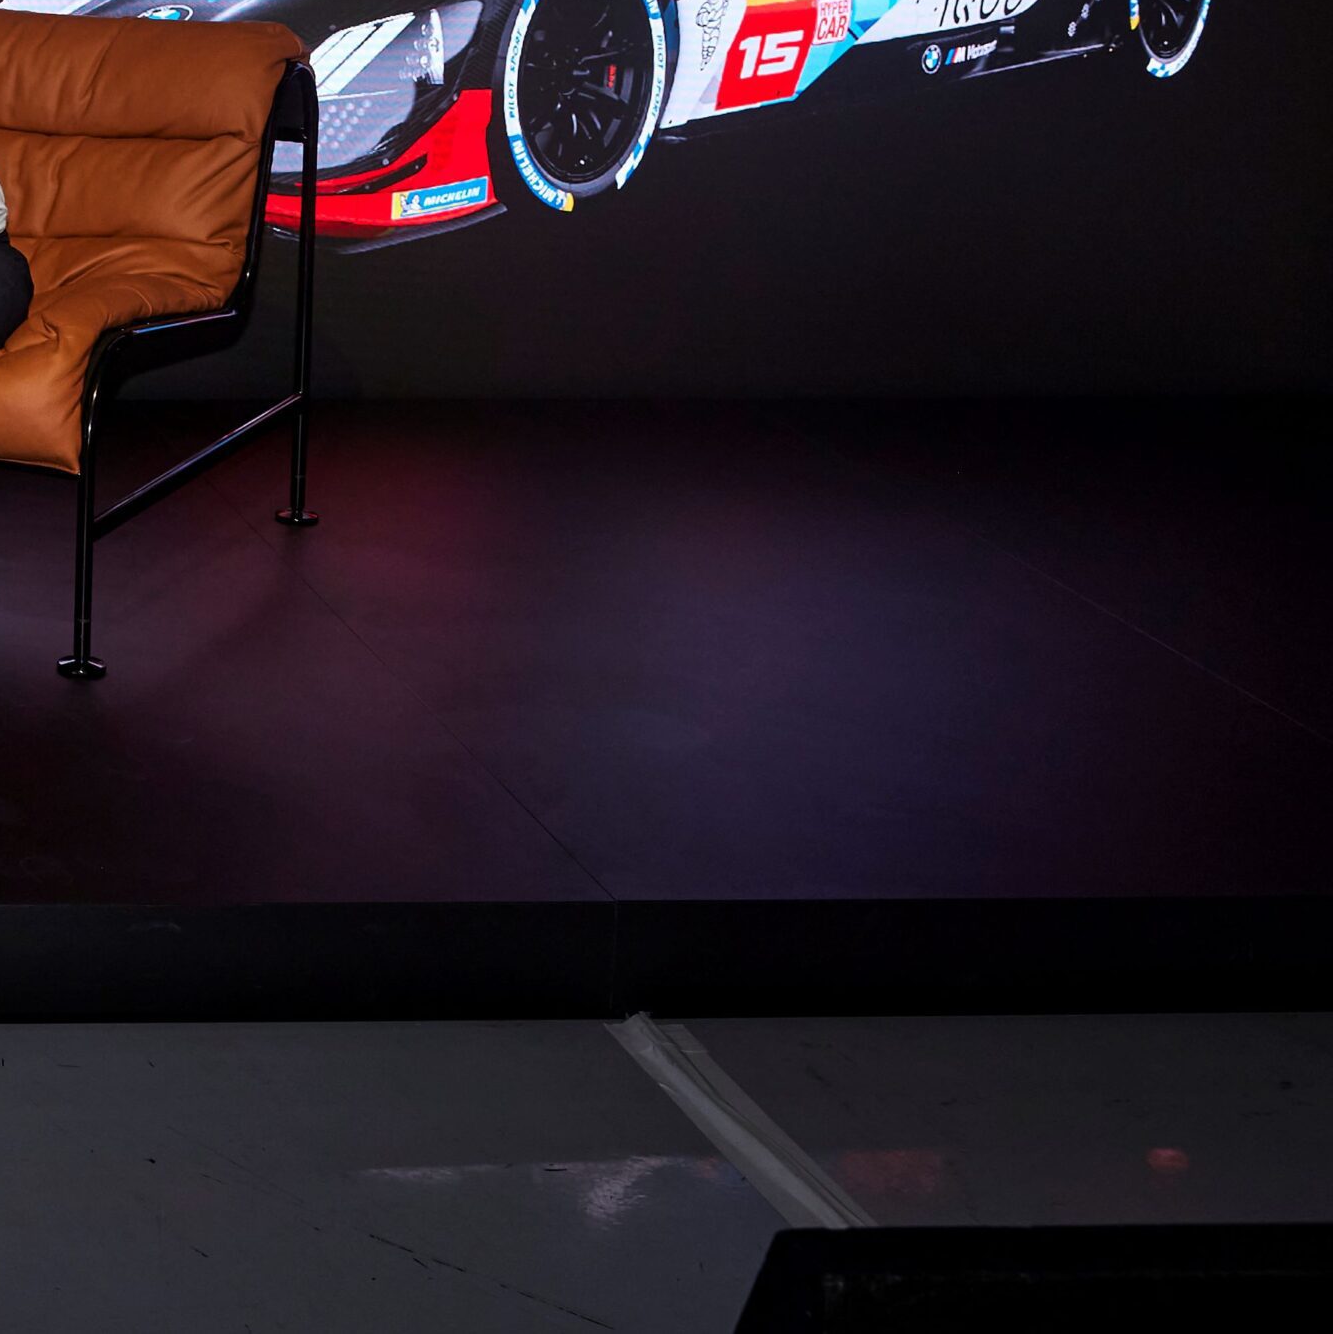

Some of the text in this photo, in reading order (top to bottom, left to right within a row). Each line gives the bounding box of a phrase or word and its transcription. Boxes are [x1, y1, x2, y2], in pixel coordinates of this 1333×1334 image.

[820, 0, 849, 17] HYPER
[817, 15, 847, 40] CAR
[739, 30, 804, 79] 15
[512, 140, 557, 203] MICHELIN
[423, 186, 481, 207] MICHELIN
